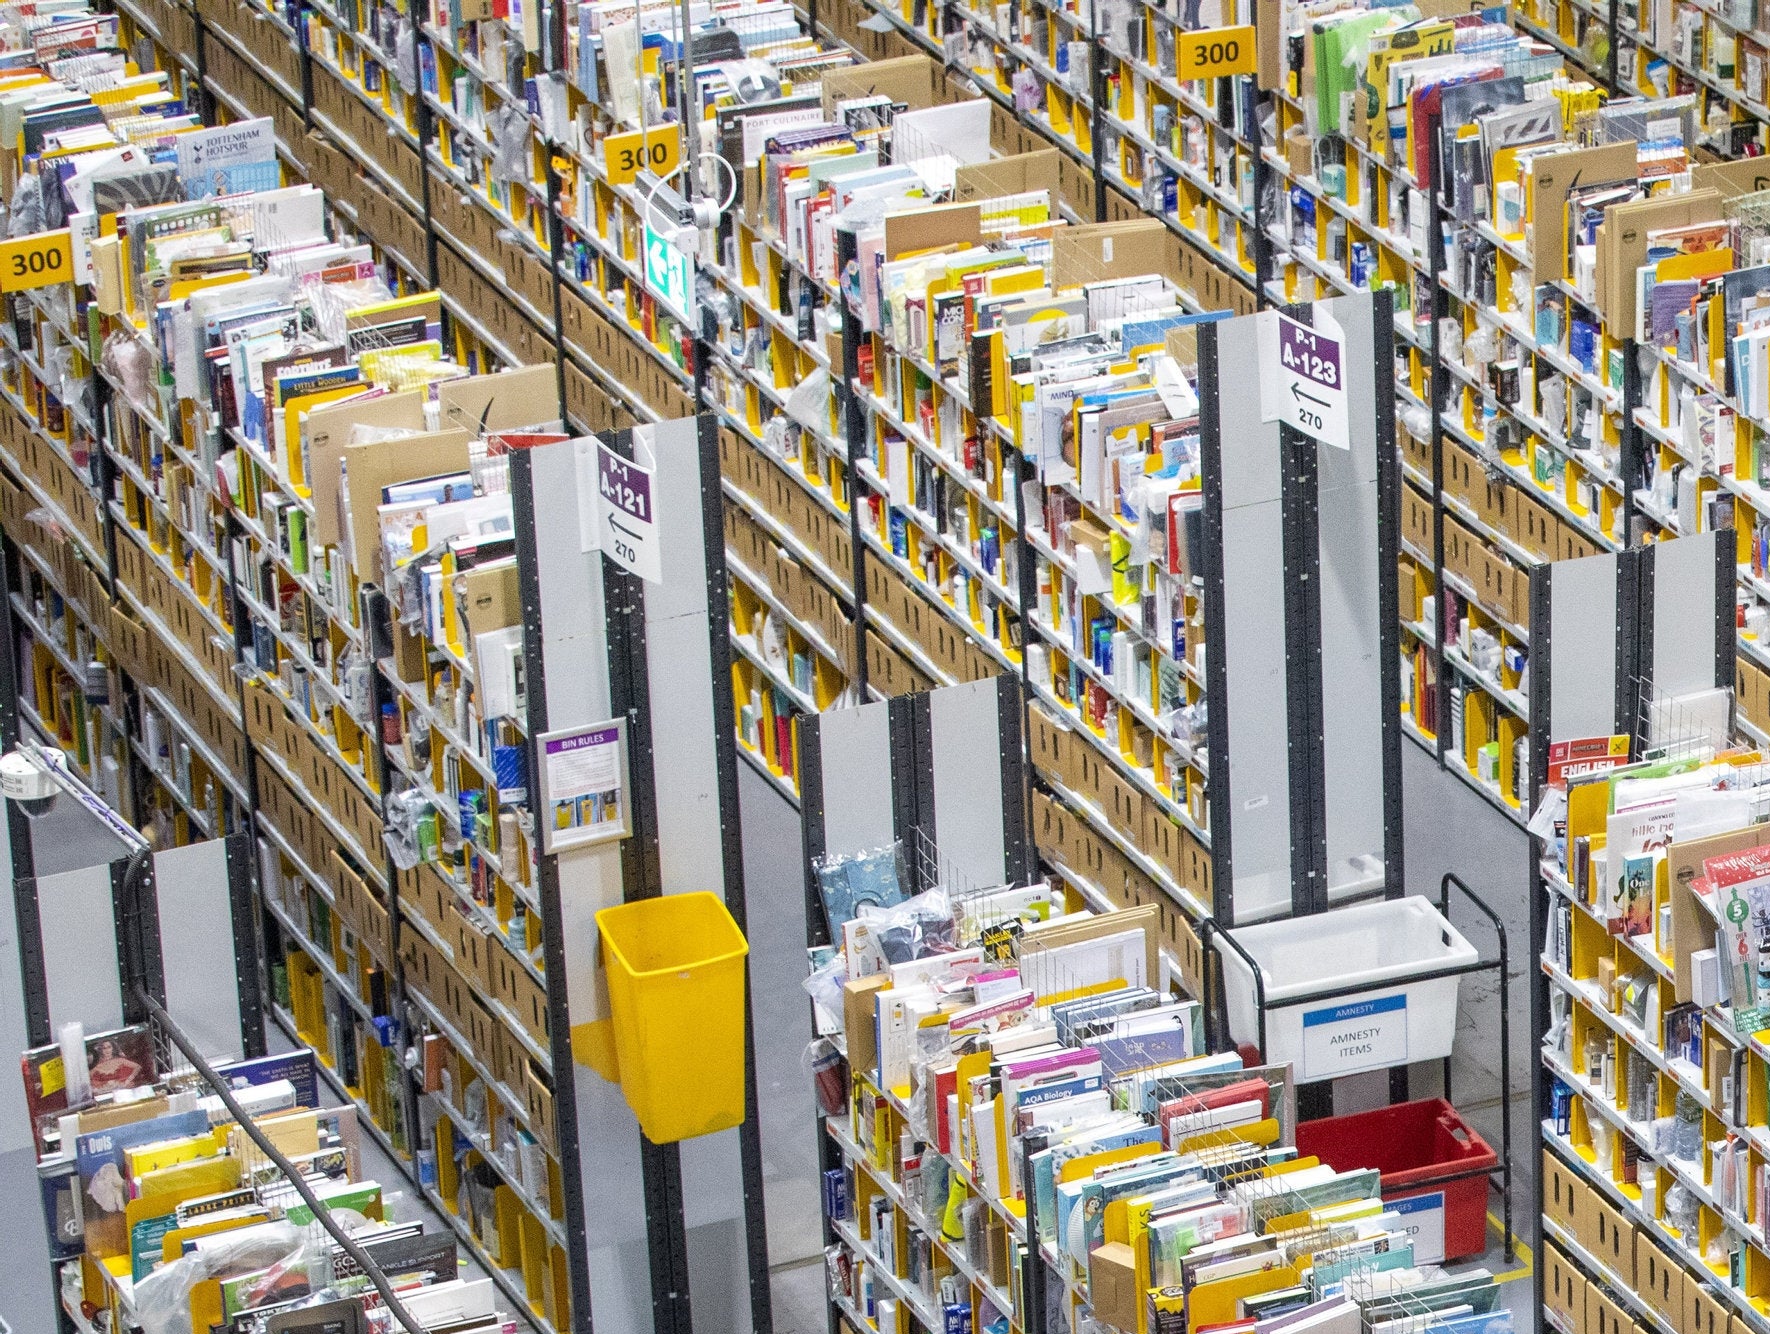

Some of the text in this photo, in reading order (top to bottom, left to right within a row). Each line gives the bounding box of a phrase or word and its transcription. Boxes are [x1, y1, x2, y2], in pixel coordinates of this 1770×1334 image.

[1194, 40, 1240, 66] 300
[206, 129, 260, 147] TOTTENHAM
[206, 142, 248, 157] HOTSPUR
[619, 142, 668, 172] 300
[12, 247, 63, 277] 300
[1295, 328, 1317, 351] P-1
[1282, 342, 1337, 385] A-123
[1299, 408, 1323, 431] 270
[610, 458, 628, 481] P-1
[600, 472, 646, 517] A-121
[615, 540, 636, 564] 270
[562, 734, 605, 751] BIN RULES
[1561, 759, 1617, 779] ENGLISH
[1335, 1003, 1375, 1018] AMNESTY
[1330, 1028, 1381, 1046] AMNESTY
[1339, 1043, 1372, 1057] ITEMS
[1024, 1088, 1073, 1104] AQA Biology
[89, 1136, 113, 1152] Owls
